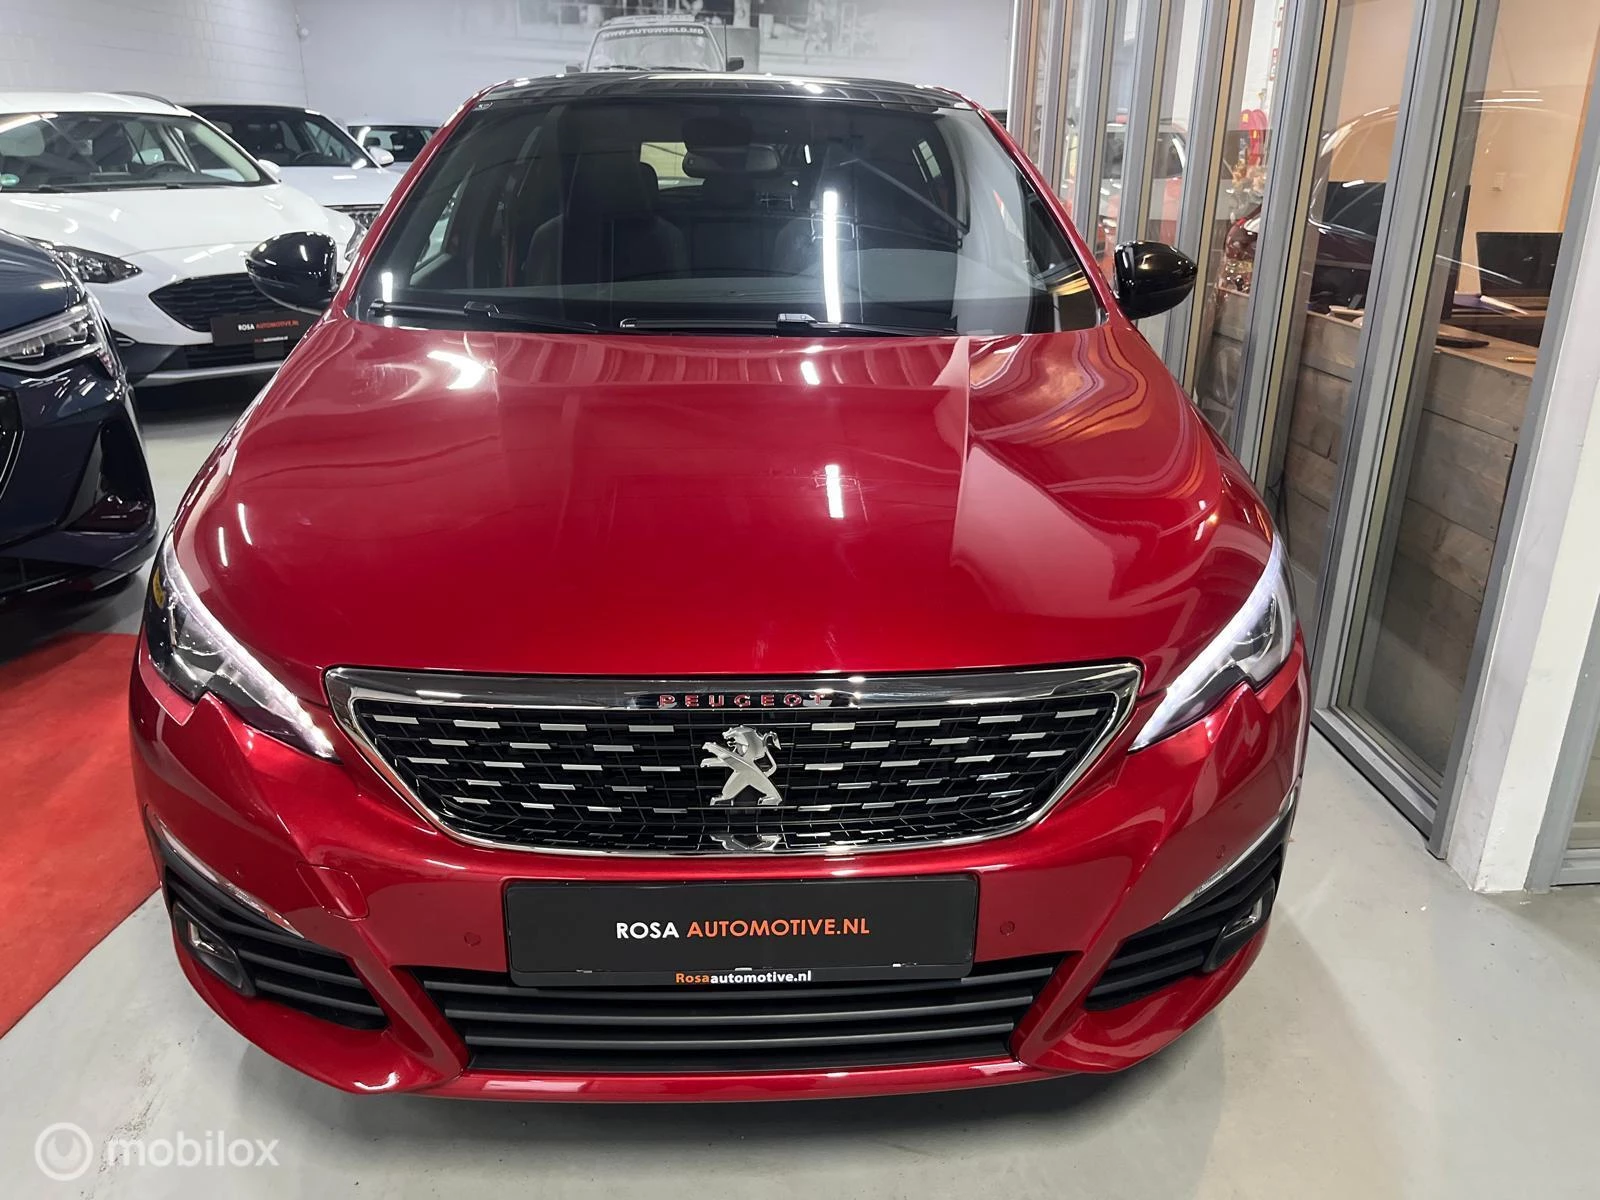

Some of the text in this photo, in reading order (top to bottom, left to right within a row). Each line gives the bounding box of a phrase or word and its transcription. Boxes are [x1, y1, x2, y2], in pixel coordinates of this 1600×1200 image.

[658, 694, 826, 708] PEUGEOT
[615, 917, 871, 940] ROSA AUTOMOTIVE.NL
[675, 969, 813, 985] Rosaautomotive.nl
